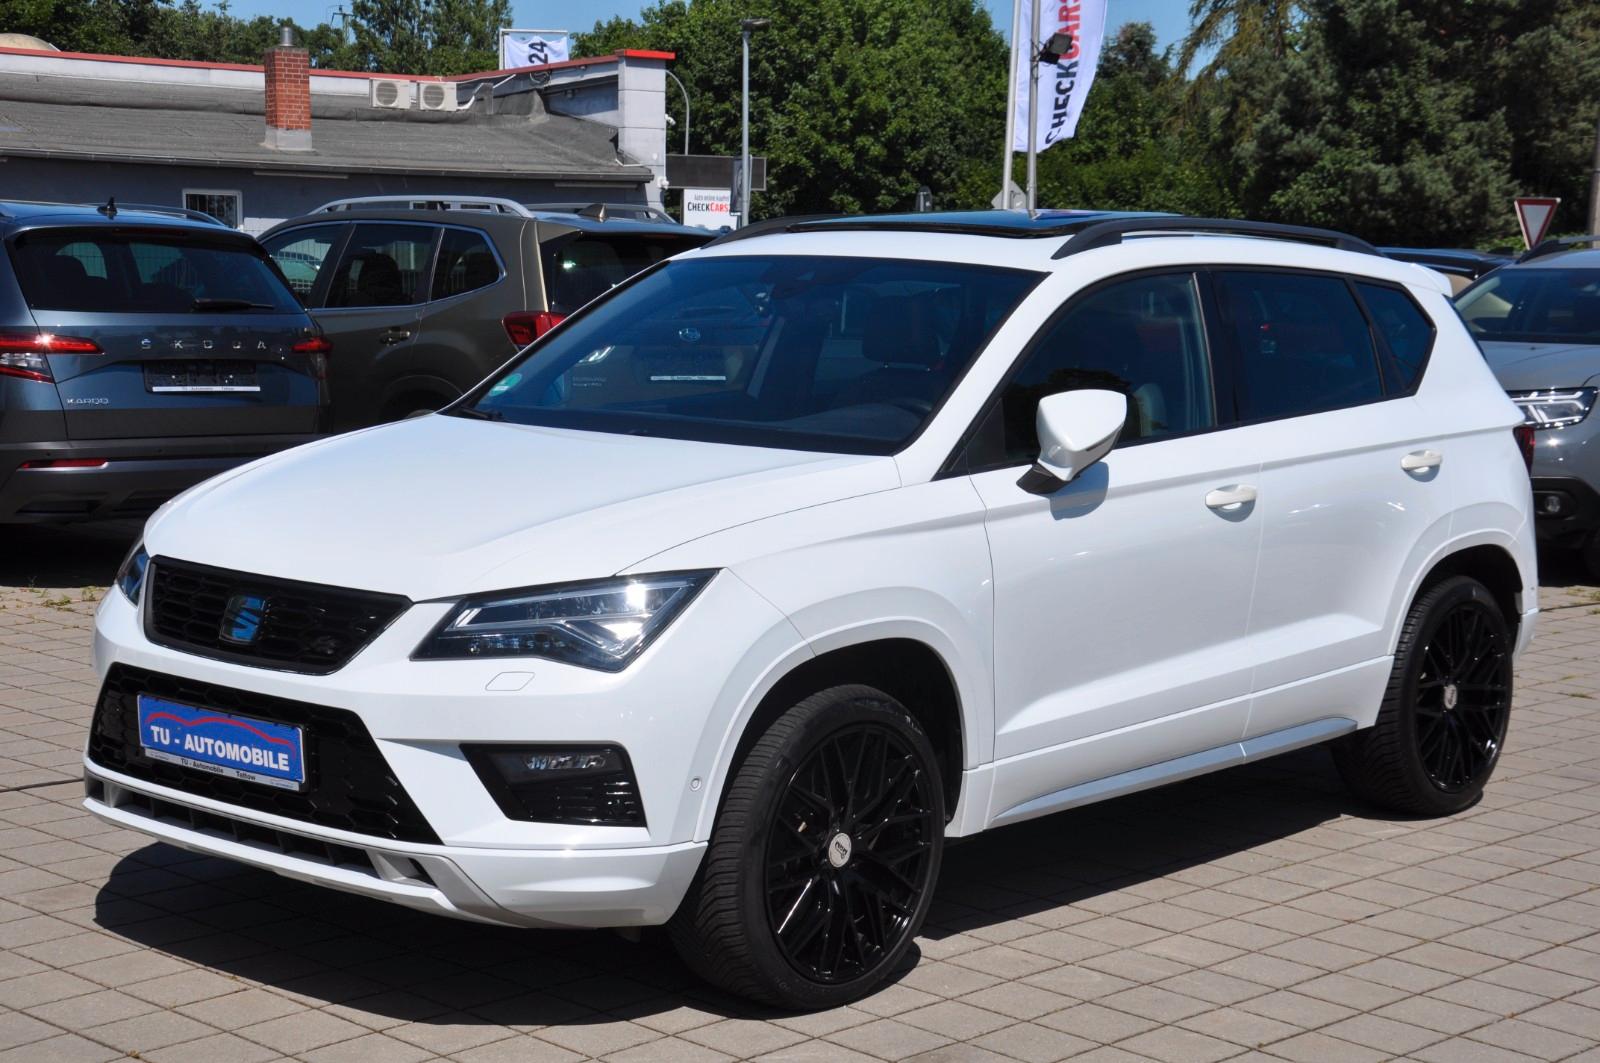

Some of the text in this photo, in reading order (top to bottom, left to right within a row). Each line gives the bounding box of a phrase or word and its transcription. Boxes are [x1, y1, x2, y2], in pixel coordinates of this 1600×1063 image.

[528, 41, 548, 64] 24
[151, 726, 169, 744] TU
[184, 734, 290, 771] AUTOMOBILE
